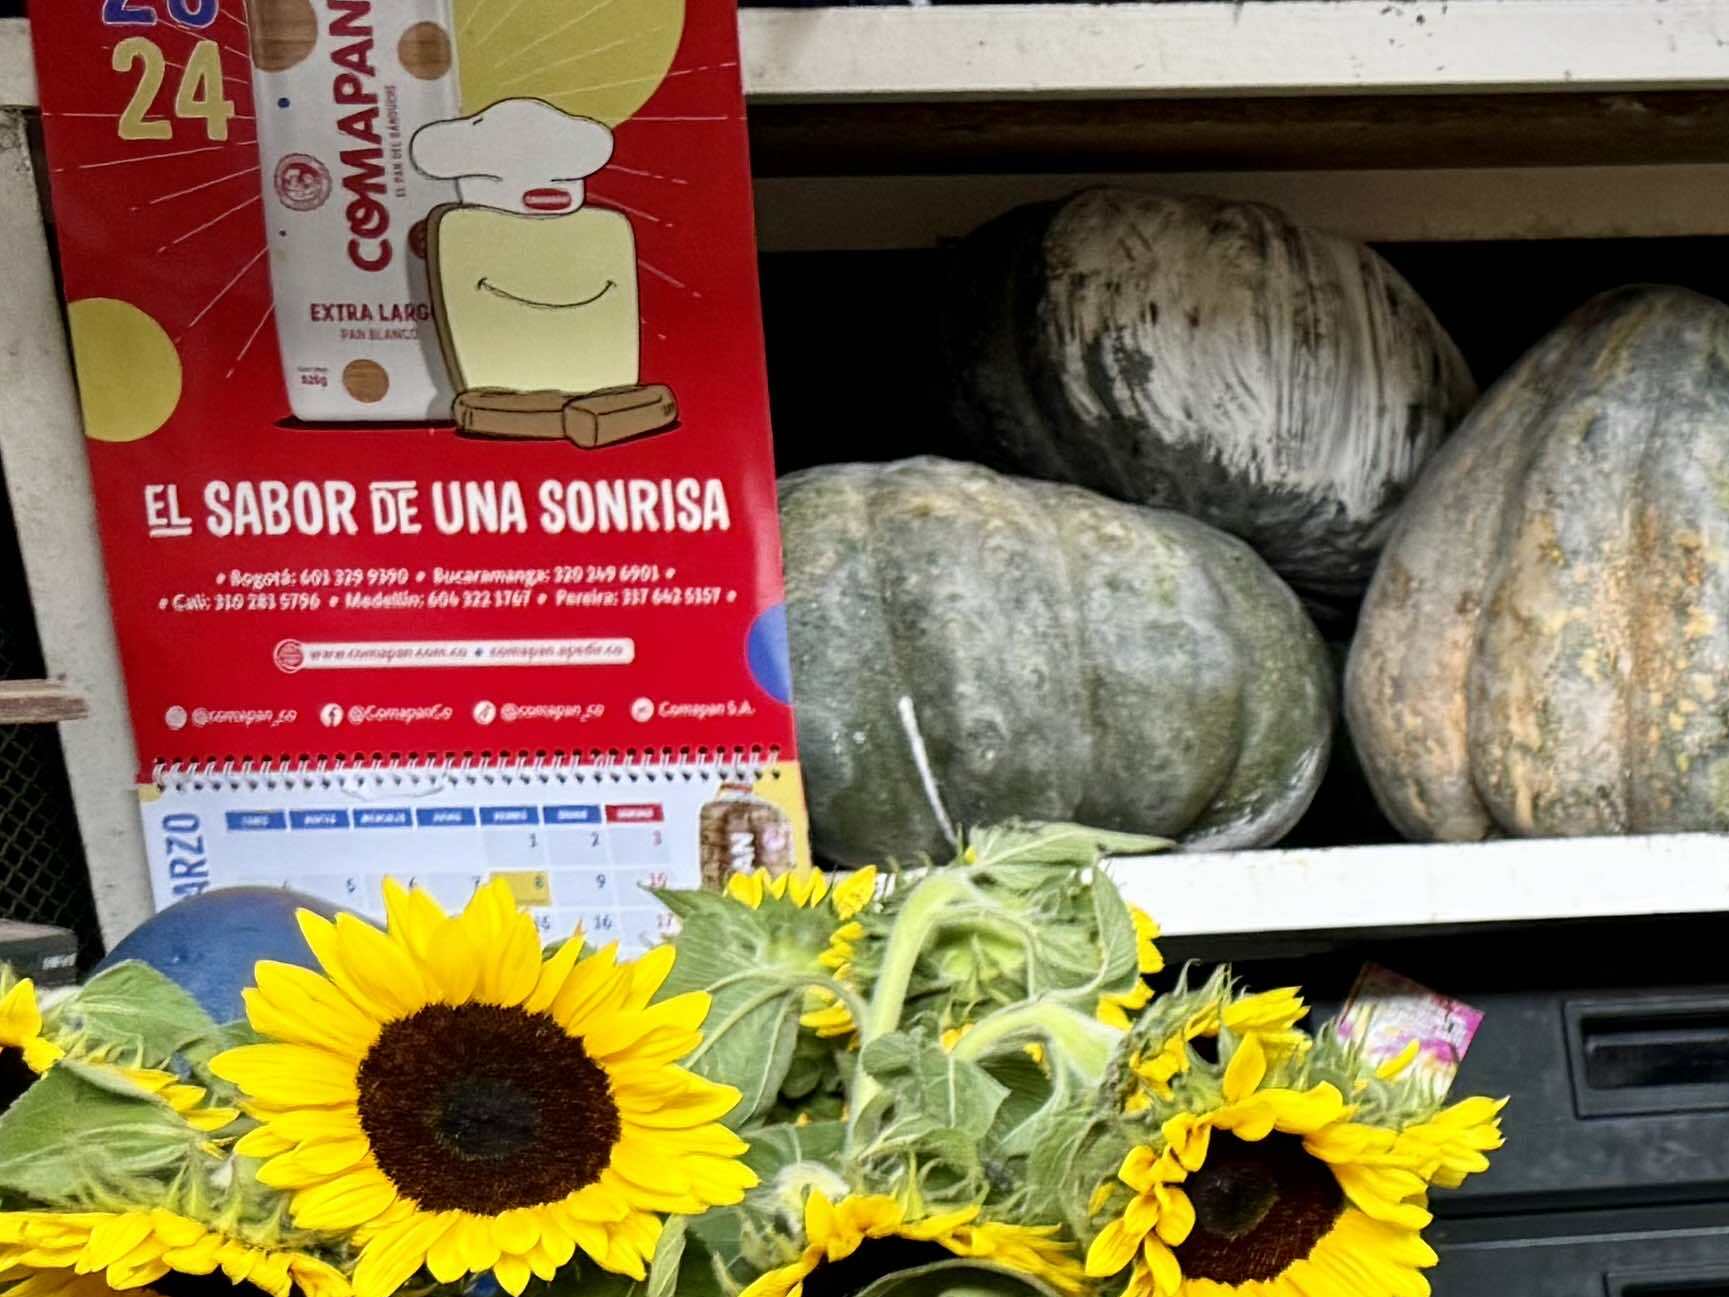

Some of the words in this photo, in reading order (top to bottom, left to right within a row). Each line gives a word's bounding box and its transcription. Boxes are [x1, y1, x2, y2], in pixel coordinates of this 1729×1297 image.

[112, 36, 235, 141] 24
[327, 0, 392, 272] COMAPAN
[310, 303, 372, 321] EXTRA
[378, 303, 433, 321] LARG
[145, 484, 192, 535] EL
[204, 480, 358, 537] SABOR
[370, 480, 422, 535] DE
[431, 480, 528, 534] UNA
[539, 477, 731, 534] SONRISA
[163, 812, 210, 896] ARZO
[529, 831, 538, 848] 1
[591, 830, 601, 847] 2
[597, 873, 607, 889] 9
